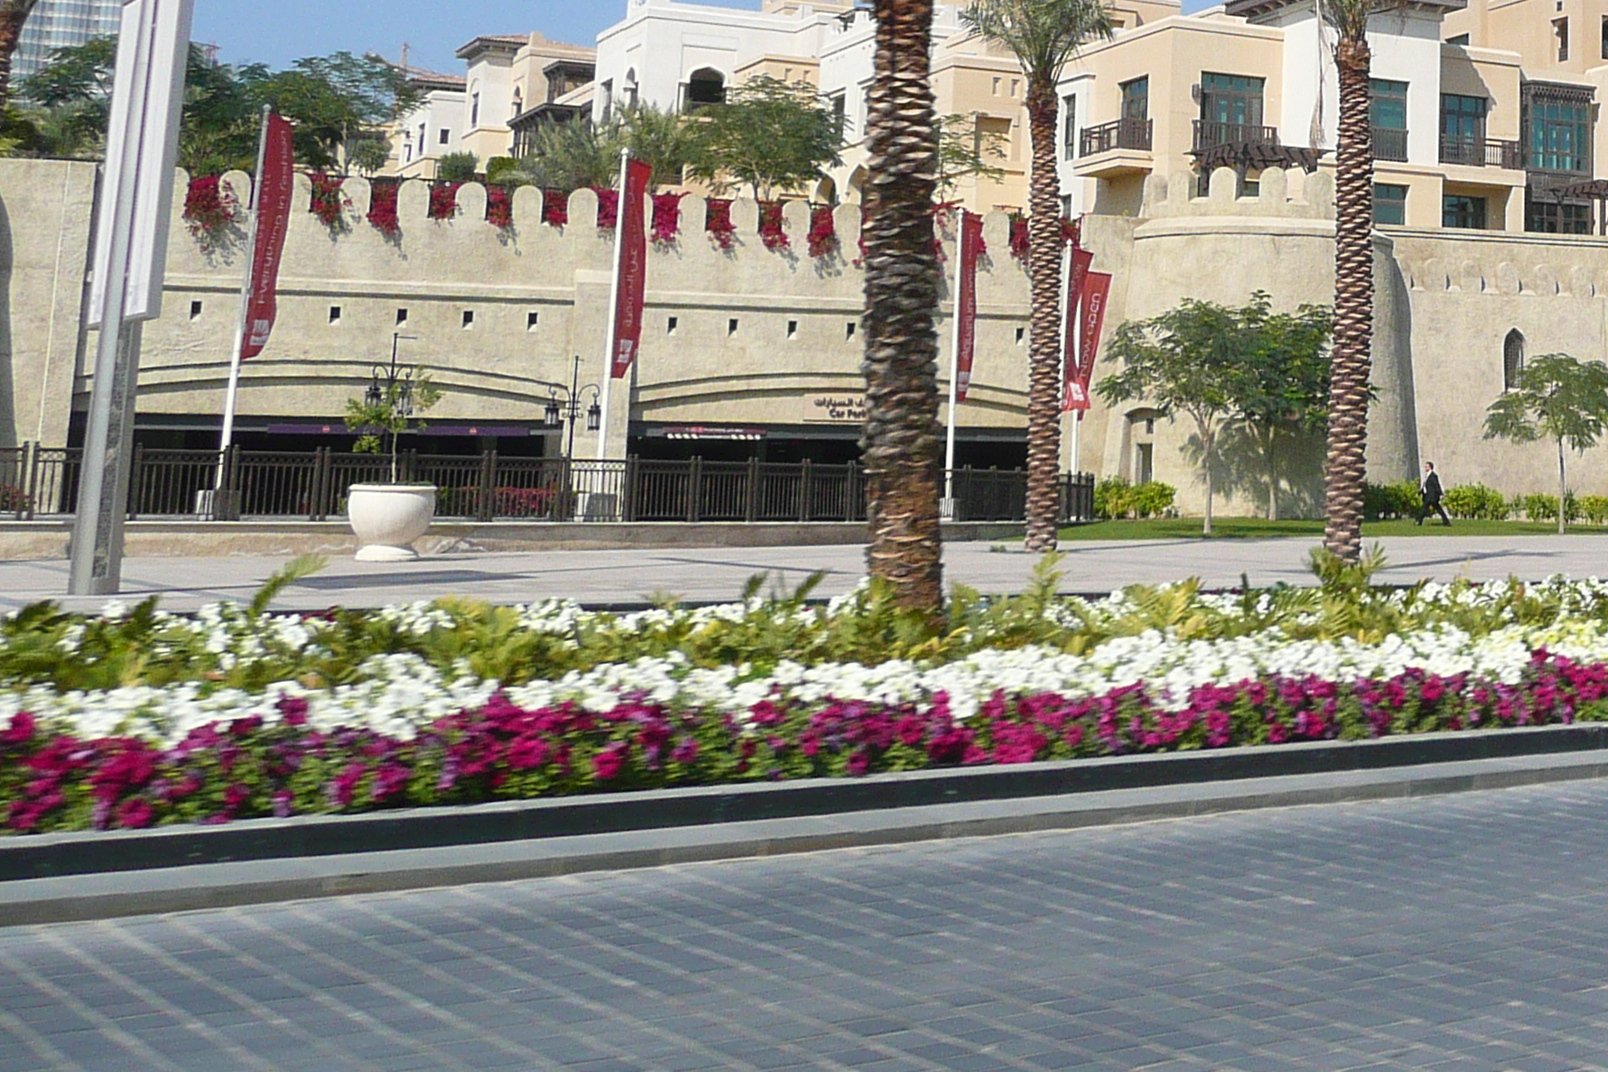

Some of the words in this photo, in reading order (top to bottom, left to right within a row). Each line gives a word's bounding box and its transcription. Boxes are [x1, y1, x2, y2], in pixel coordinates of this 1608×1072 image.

[278, 130, 289, 191] fashion
[276, 195, 286, 210] in
[257, 214, 283, 304] Everything
[1080, 339, 1092, 378] Now
[1086, 292, 1102, 336] open
[829, 408, 845, 418] Car
